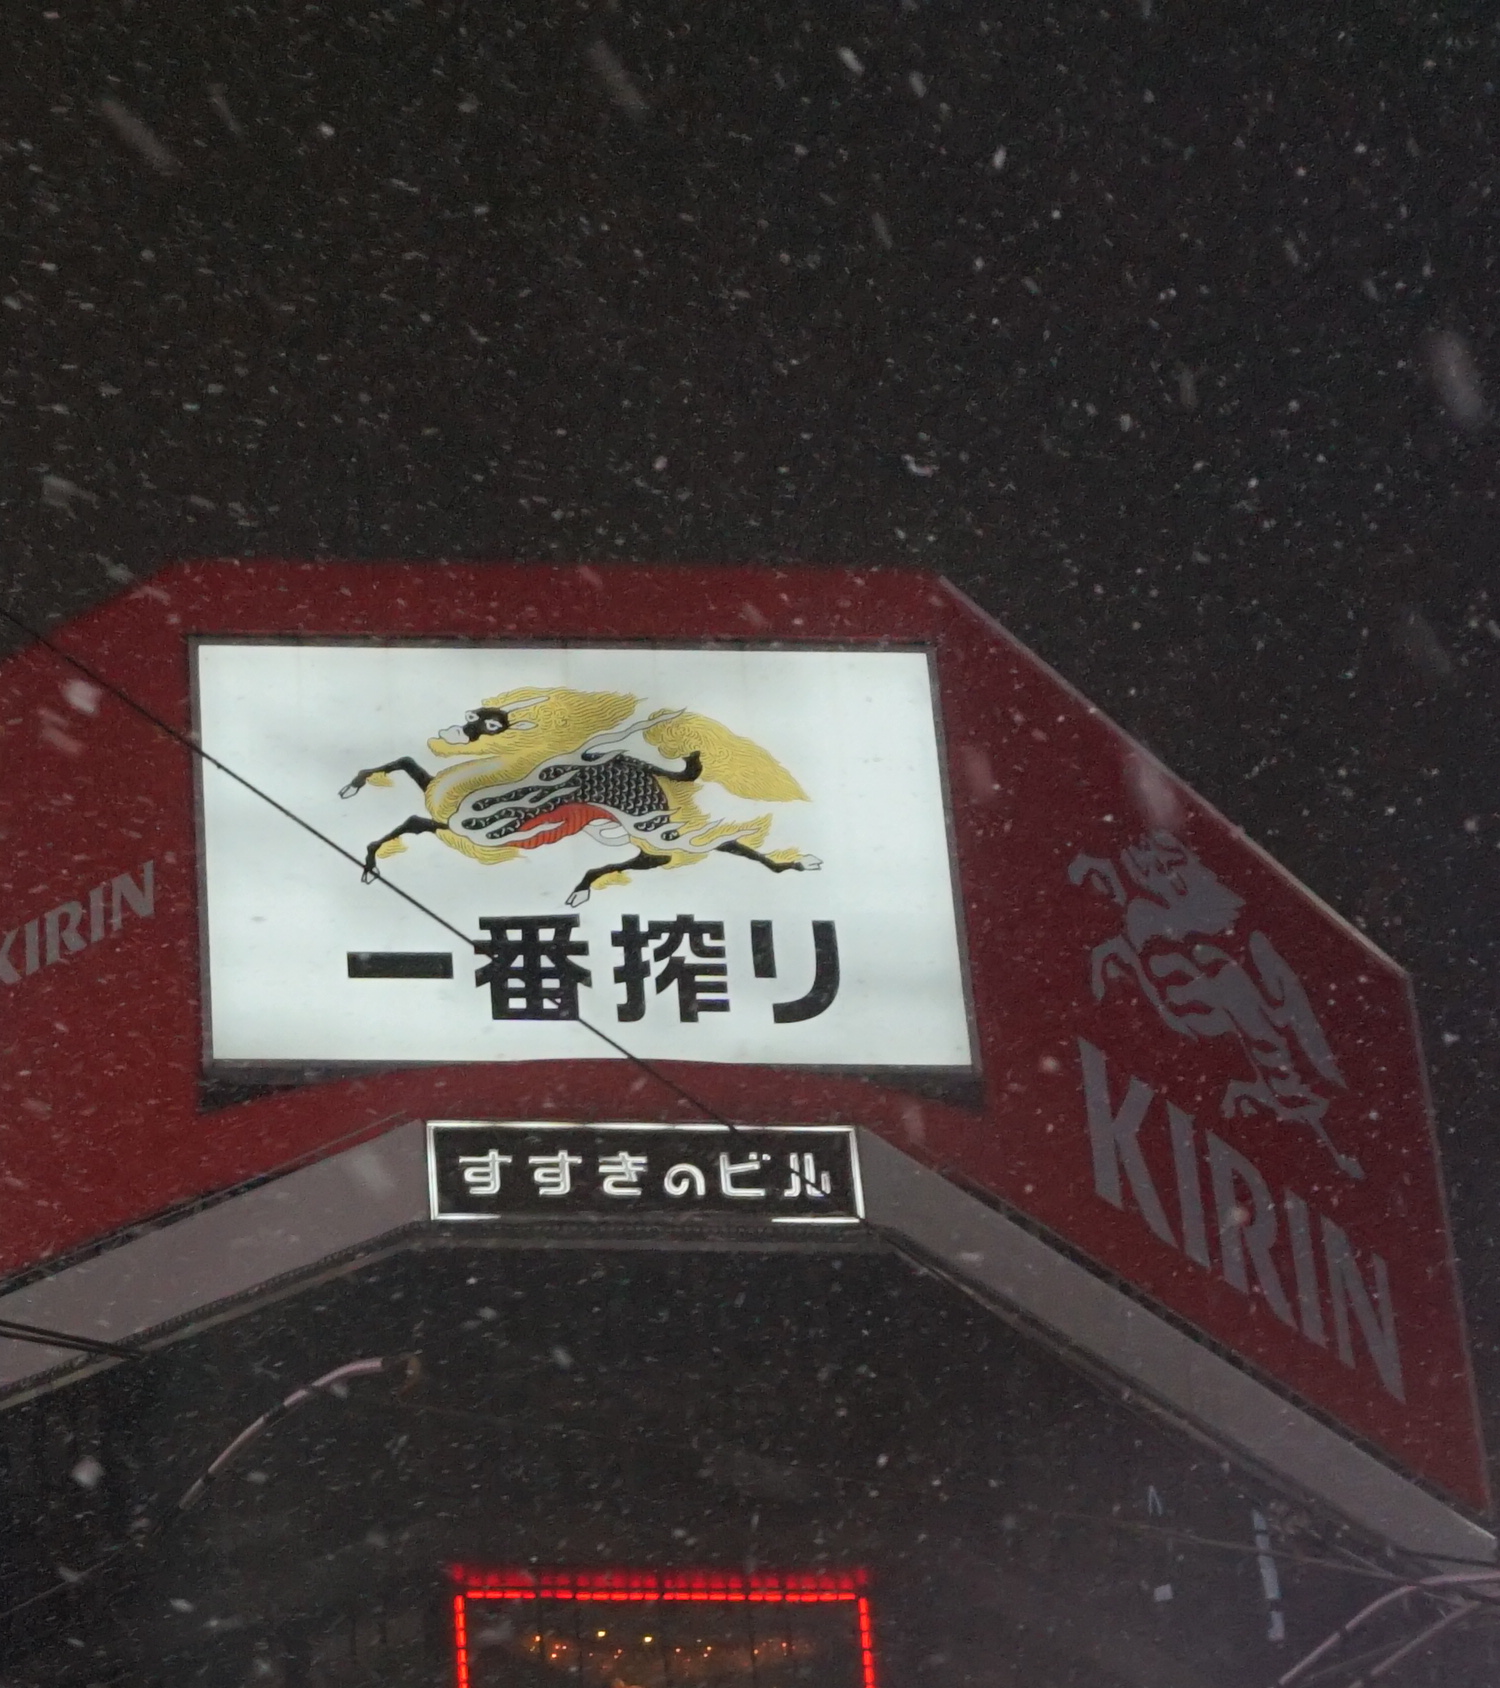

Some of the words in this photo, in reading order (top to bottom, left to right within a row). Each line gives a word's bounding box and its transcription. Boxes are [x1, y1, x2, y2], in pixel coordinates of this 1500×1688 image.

[346, 911, 842, 1025] 一番搾り
[459, 1146, 830, 1199] すすきのビル
[1078, 1036, 1406, 1405] KIRIN
